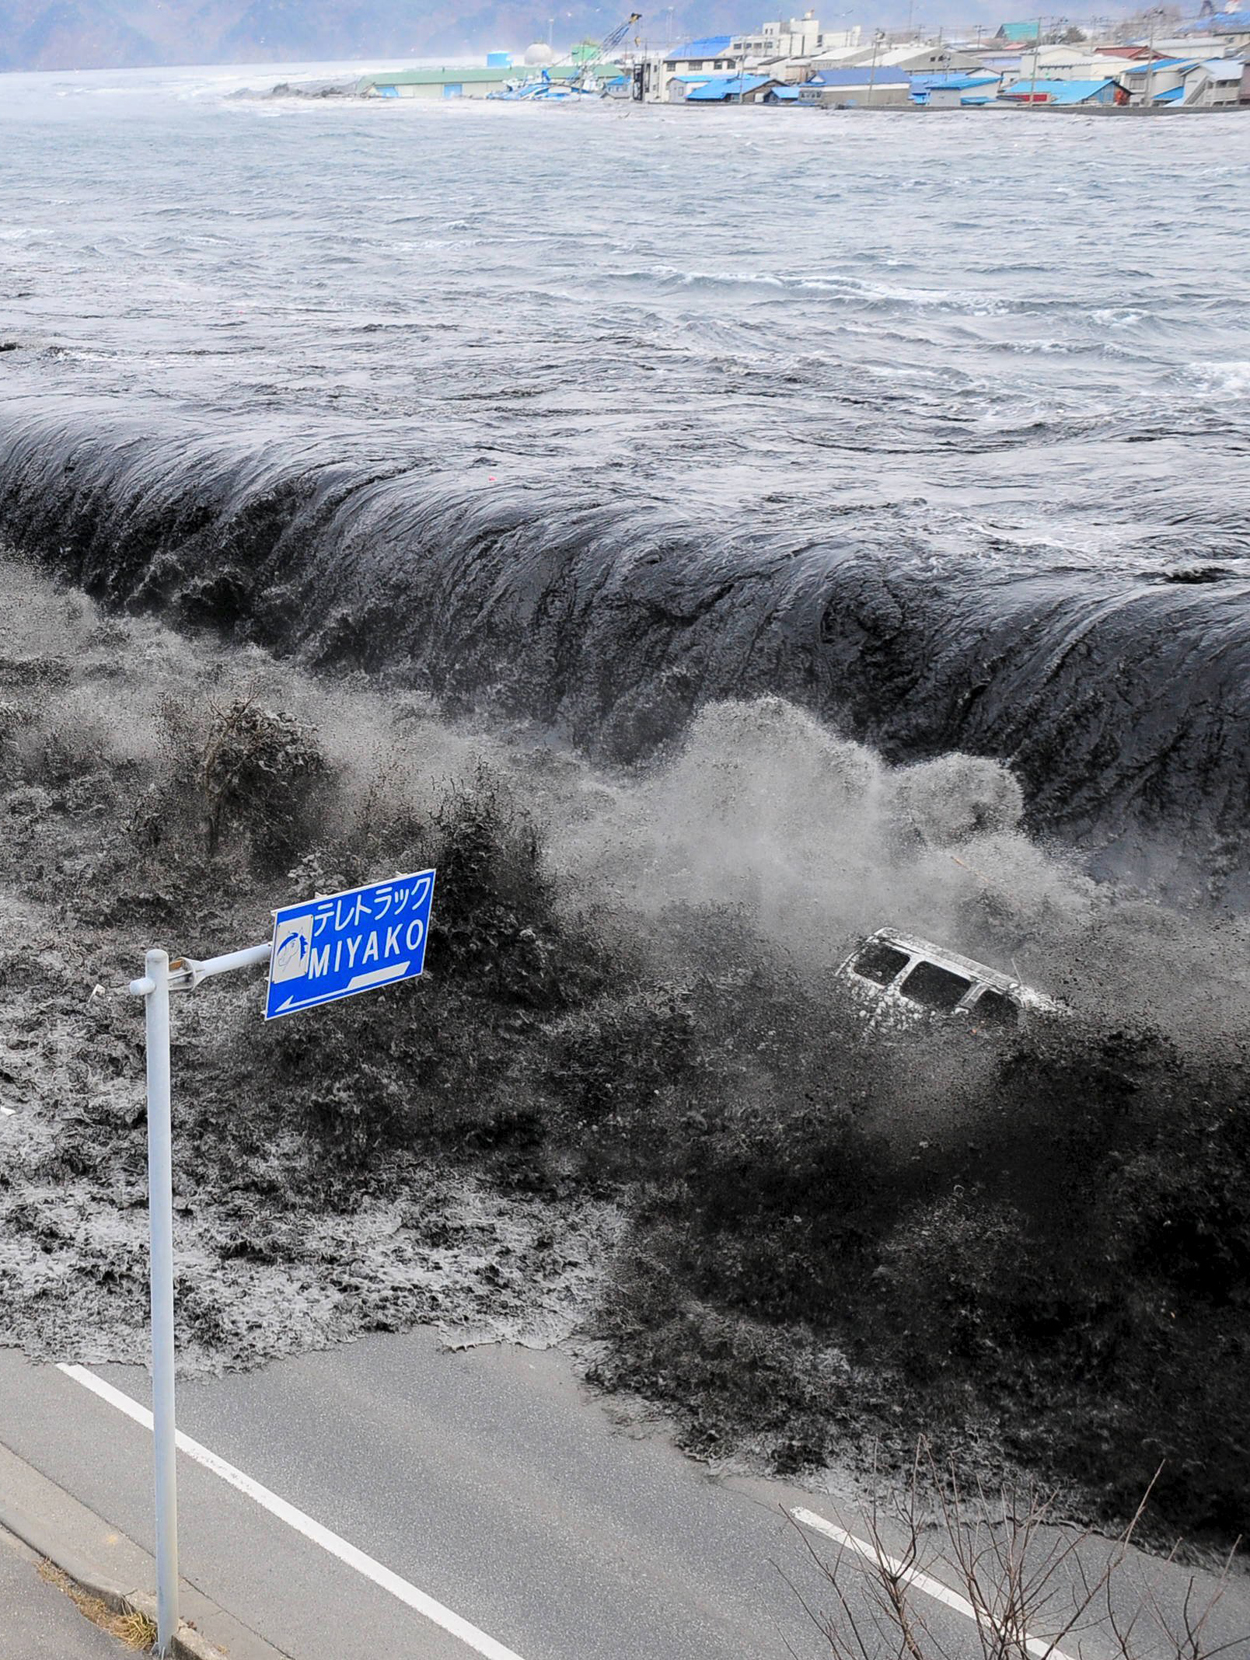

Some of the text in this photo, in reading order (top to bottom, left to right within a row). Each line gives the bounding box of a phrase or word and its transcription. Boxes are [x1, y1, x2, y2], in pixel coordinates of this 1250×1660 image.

[314, 878, 431, 937] テレトラック
[308, 919, 424, 980] MIYAKO
